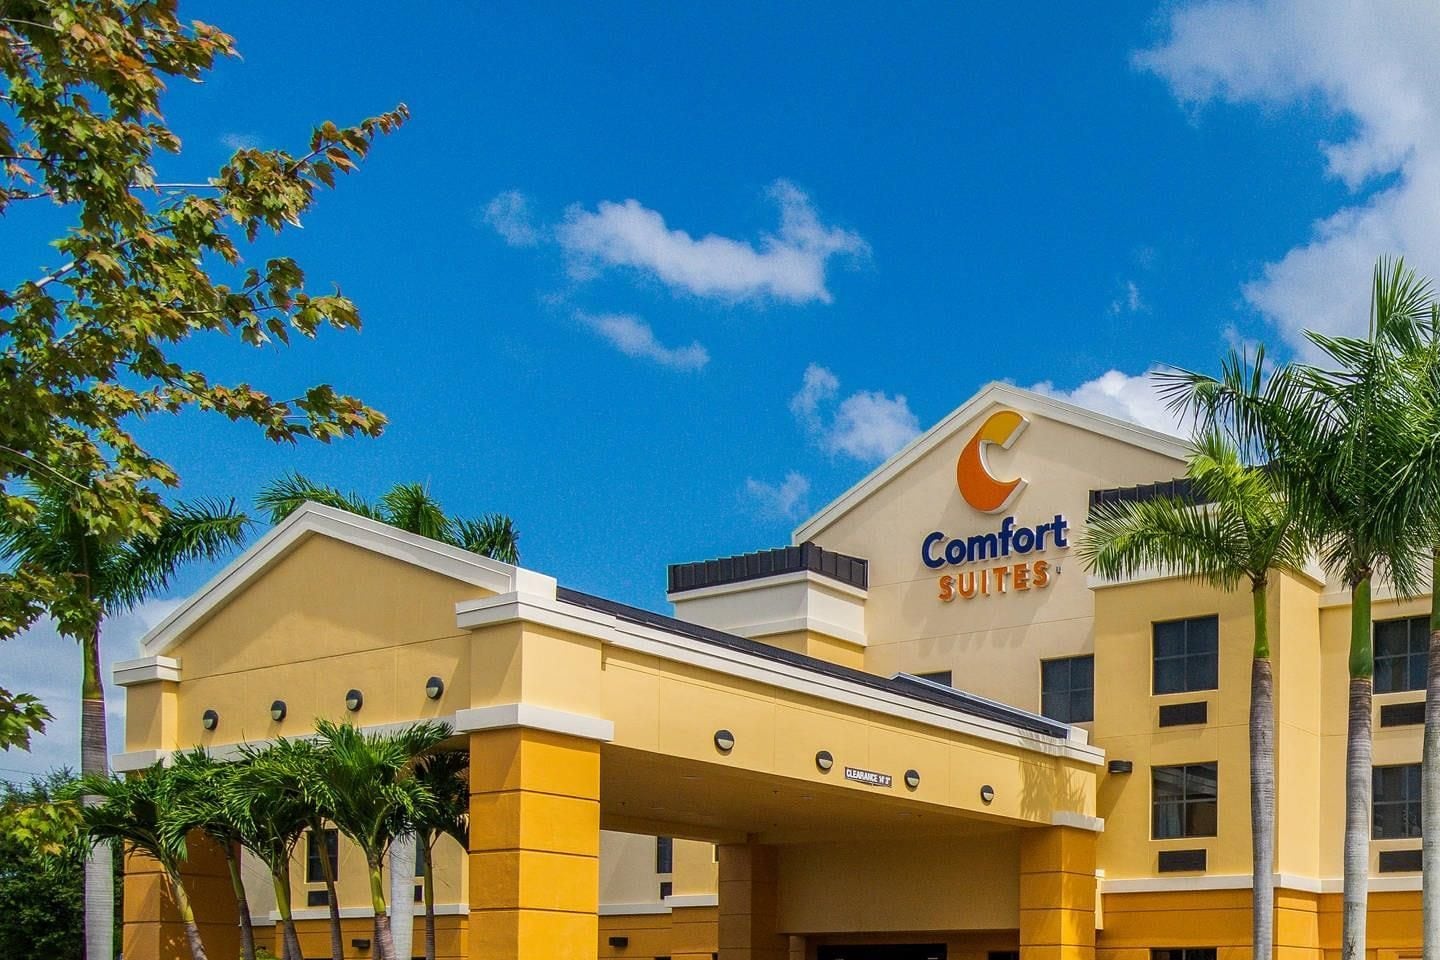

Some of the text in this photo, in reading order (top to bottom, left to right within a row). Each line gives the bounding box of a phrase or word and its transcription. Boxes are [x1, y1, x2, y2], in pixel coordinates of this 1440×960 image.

[922, 514, 1069, 570] Comfort
[938, 560, 1051, 602] SUITES
[846, 768, 878, 783] CLEARANCE
